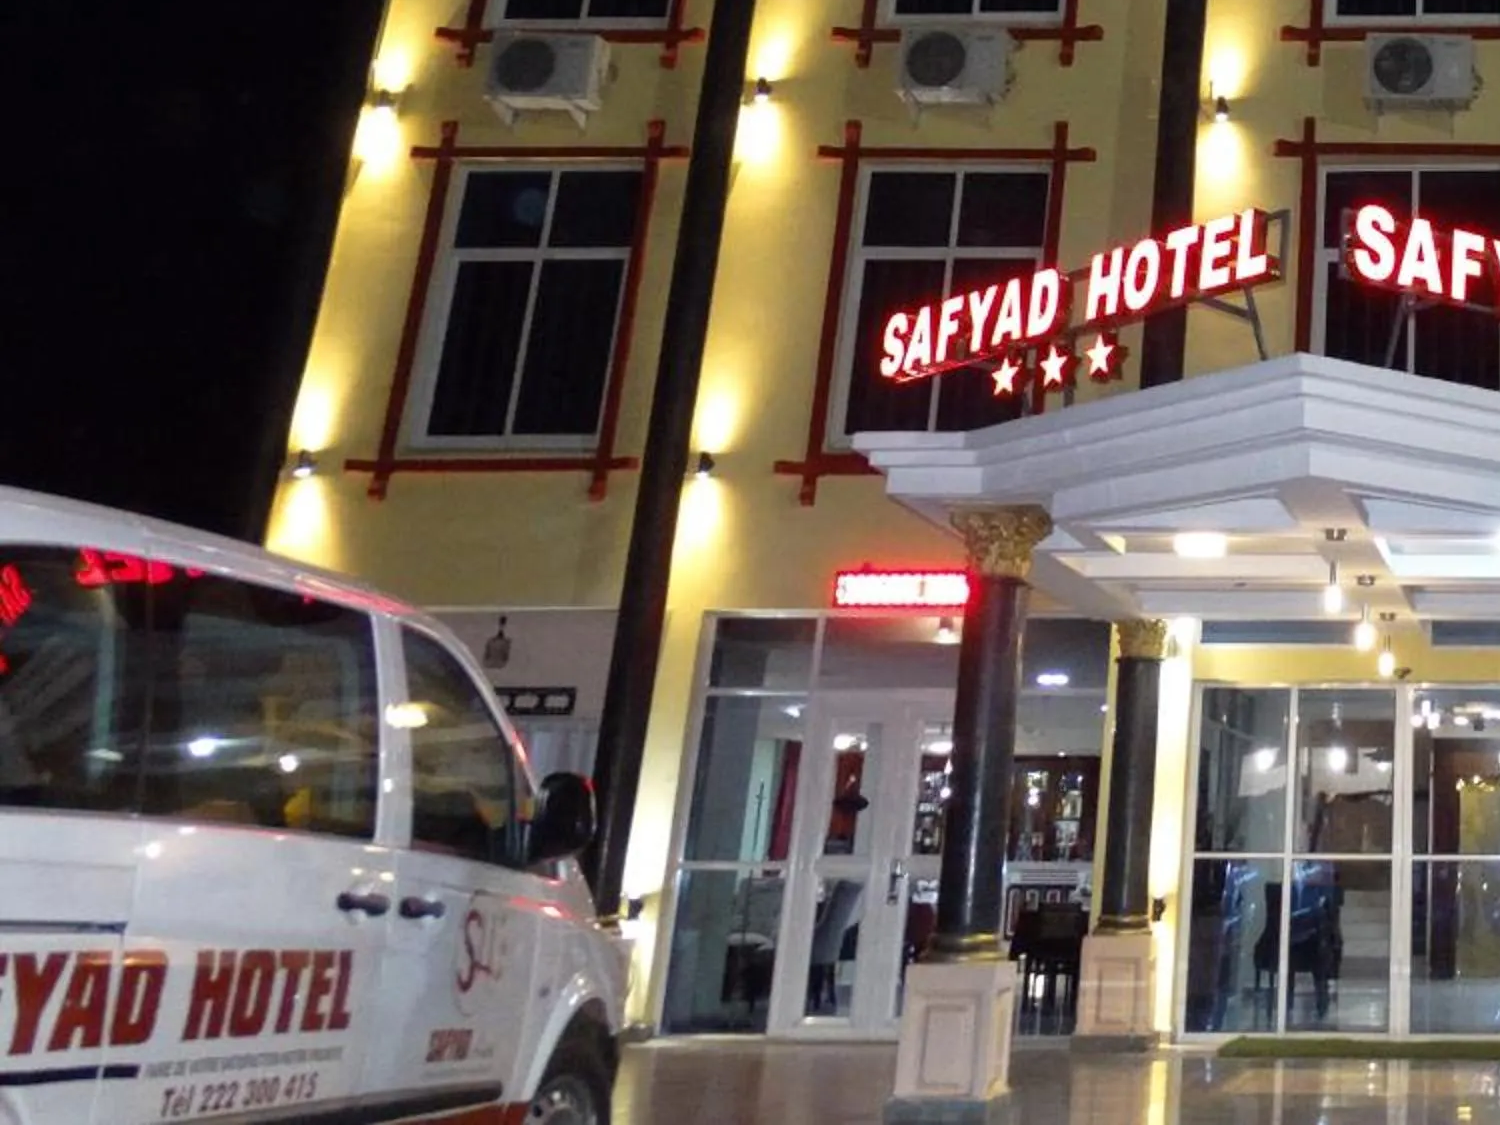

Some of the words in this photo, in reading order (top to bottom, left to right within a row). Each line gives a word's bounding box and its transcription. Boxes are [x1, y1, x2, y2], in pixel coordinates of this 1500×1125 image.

[880, 268, 1061, 377] SAFYAD
[1085, 208, 1268, 321] HOTEL
[181, 948, 355, 1042] HOTEL
[198, 1081, 239, 1113] 222
[243, 1076, 281, 1106] 300
[285, 1072, 319, 1100] 415
